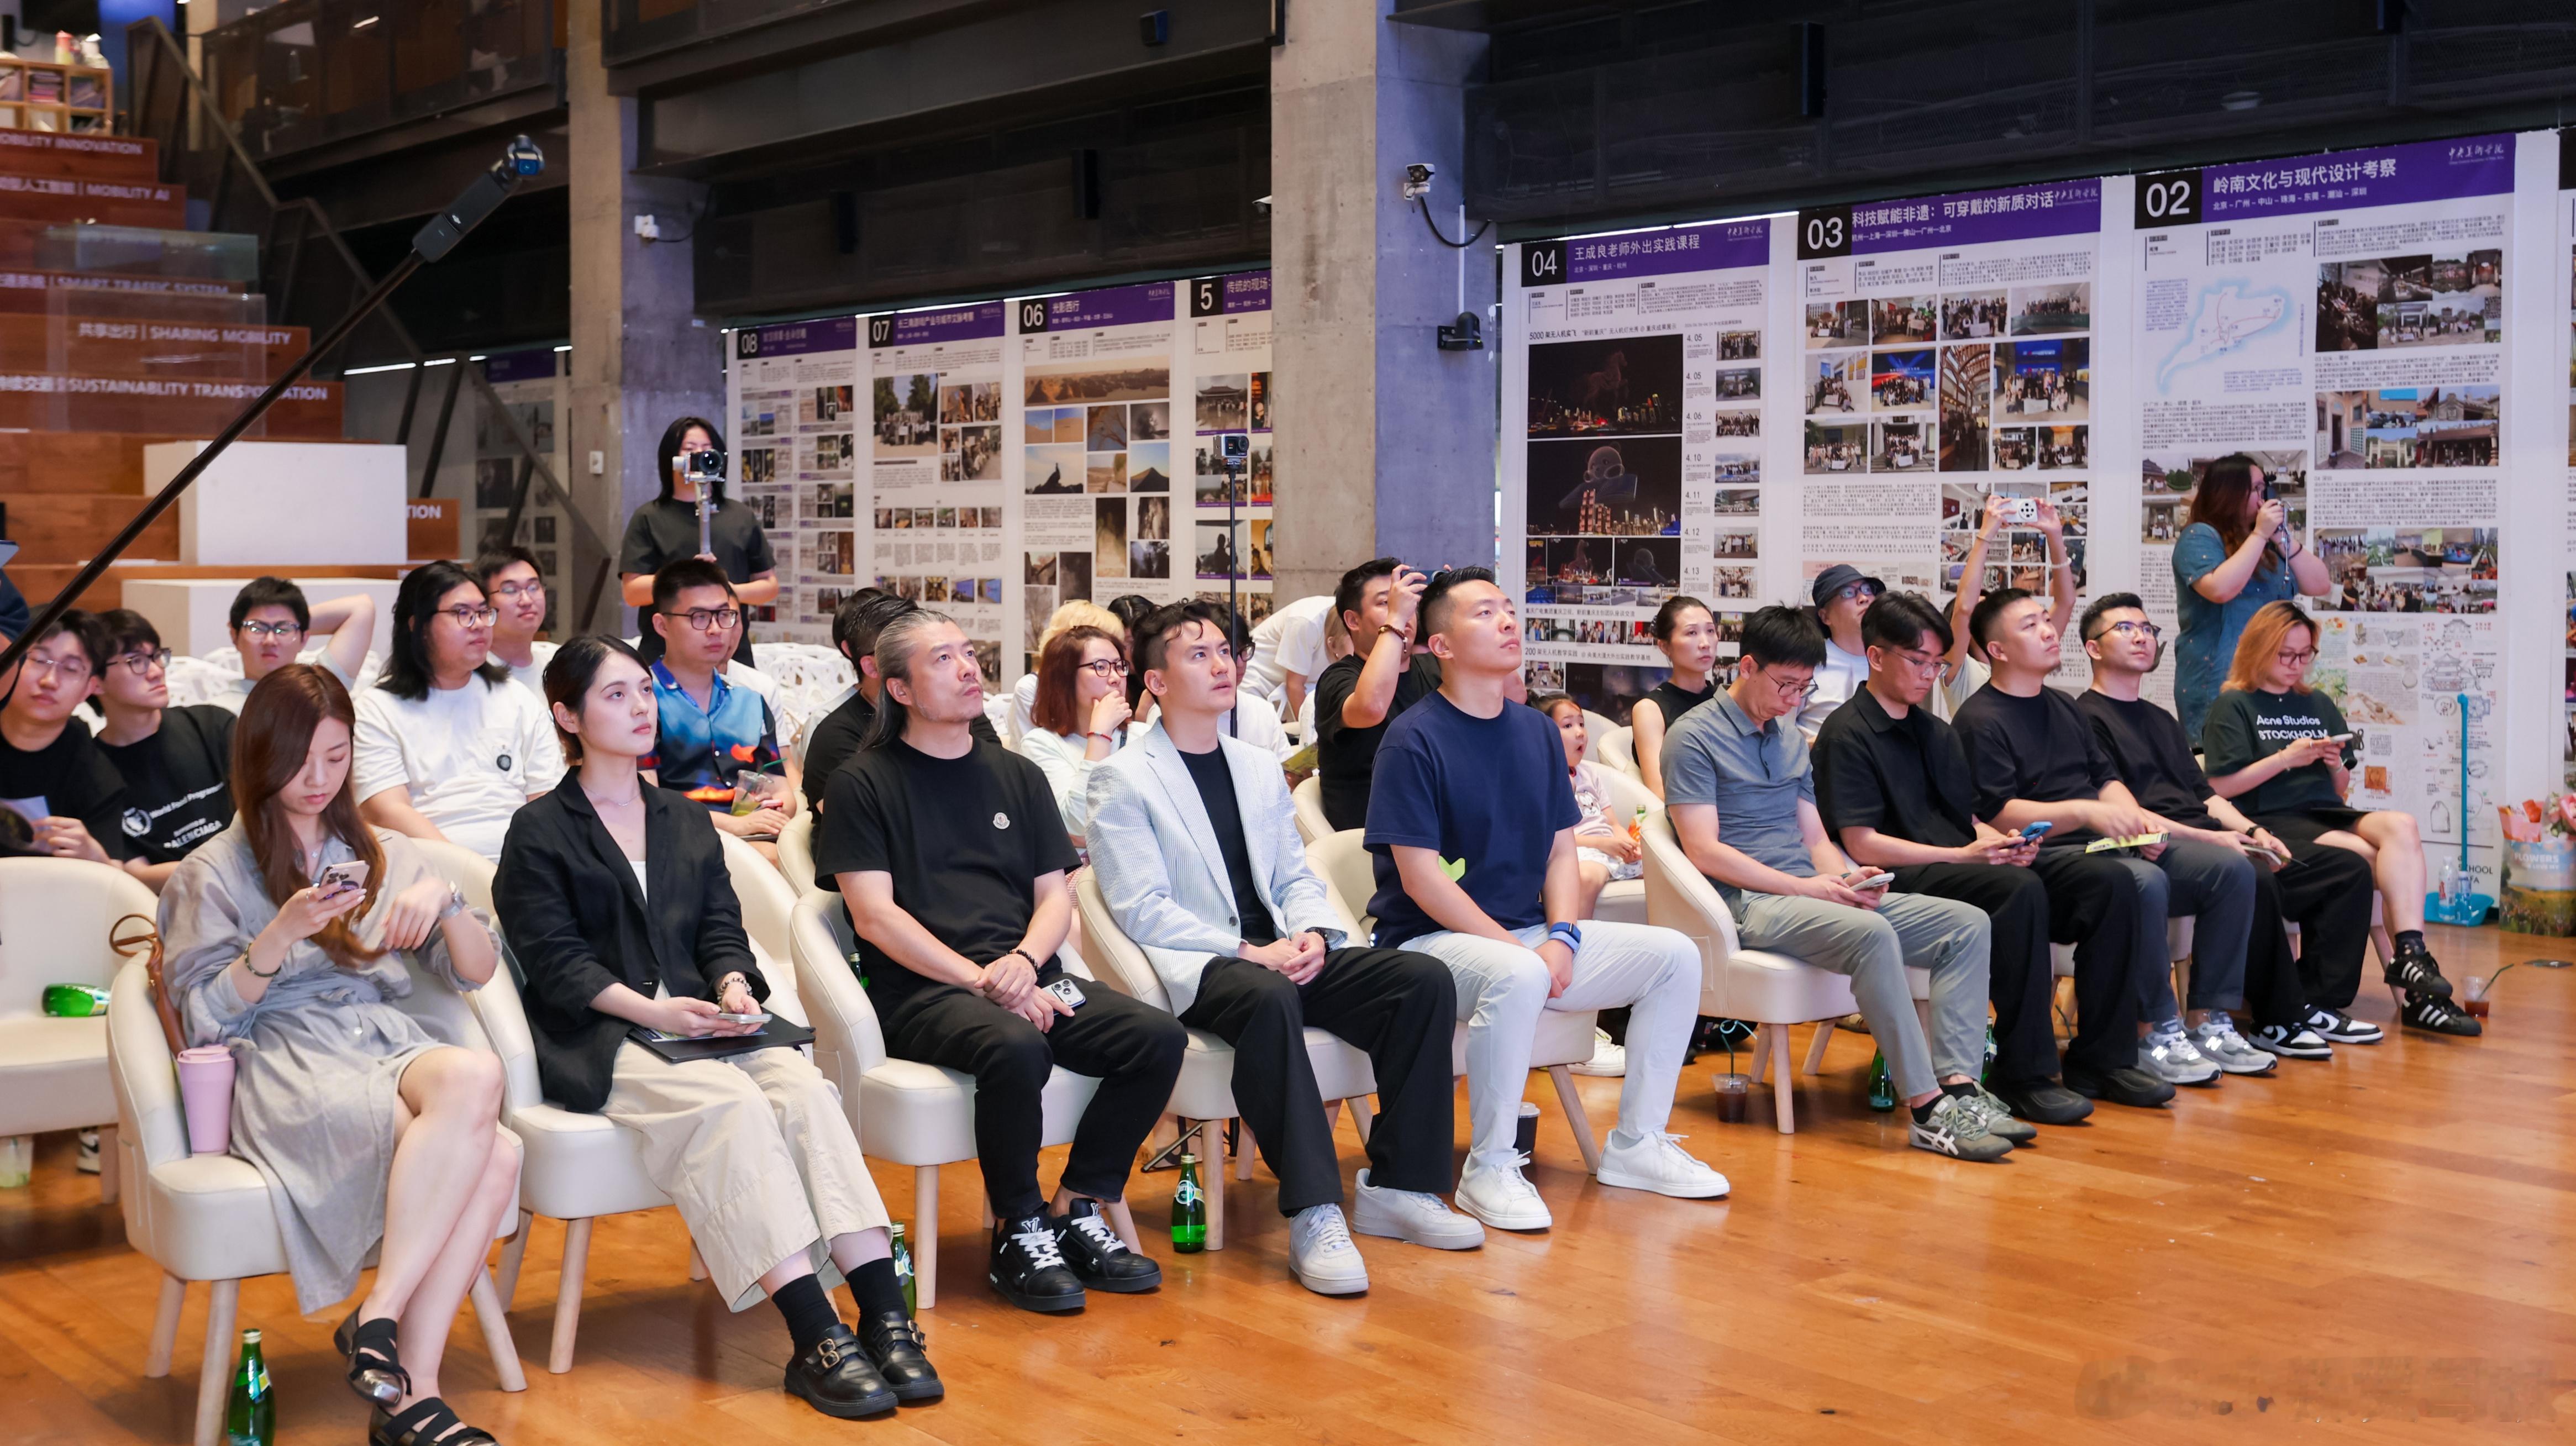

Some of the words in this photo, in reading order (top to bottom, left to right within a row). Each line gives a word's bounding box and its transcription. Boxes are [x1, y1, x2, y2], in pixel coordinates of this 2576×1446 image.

[0, 133, 51, 147] OBILITY
[2213, 159, 2396, 194] 岭南文化与现代设计考察
[2146, 181, 2190, 218] 02
[2213, 201, 2227, 211] 北京
[2235, 199, 2250, 208] 广州
[2258, 197, 2273, 207] 中山
[2351, 187, 2367, 197] 深圳
[1807, 217, 1843, 250] 03
[1575, 234, 1700, 260] 王成良老师外出实践课程
[1532, 249, 1558, 277] 04
[1200, 283, 1213, 311] 5
[1023, 303, 1043, 327] 06
[149, 326, 218, 343] SHARING
[222, 329, 291, 345] MOBILITY
[872, 320, 890, 342] 07
[1529, 332, 1544, 340] 5000
[741, 333, 758, 354] 08
[193, 383, 327, 401] TRANSPOATION
[1525, 647, 1536, 656] 200
[2256, 714, 2283, 725] Acne
[2283, 715, 2321, 725] Studios
[2258, 729, 2328, 740] STOCKHOLM
[2515, 853, 2559, 863] FLOWERS
[2458, 864, 2493, 875] SHOOL
